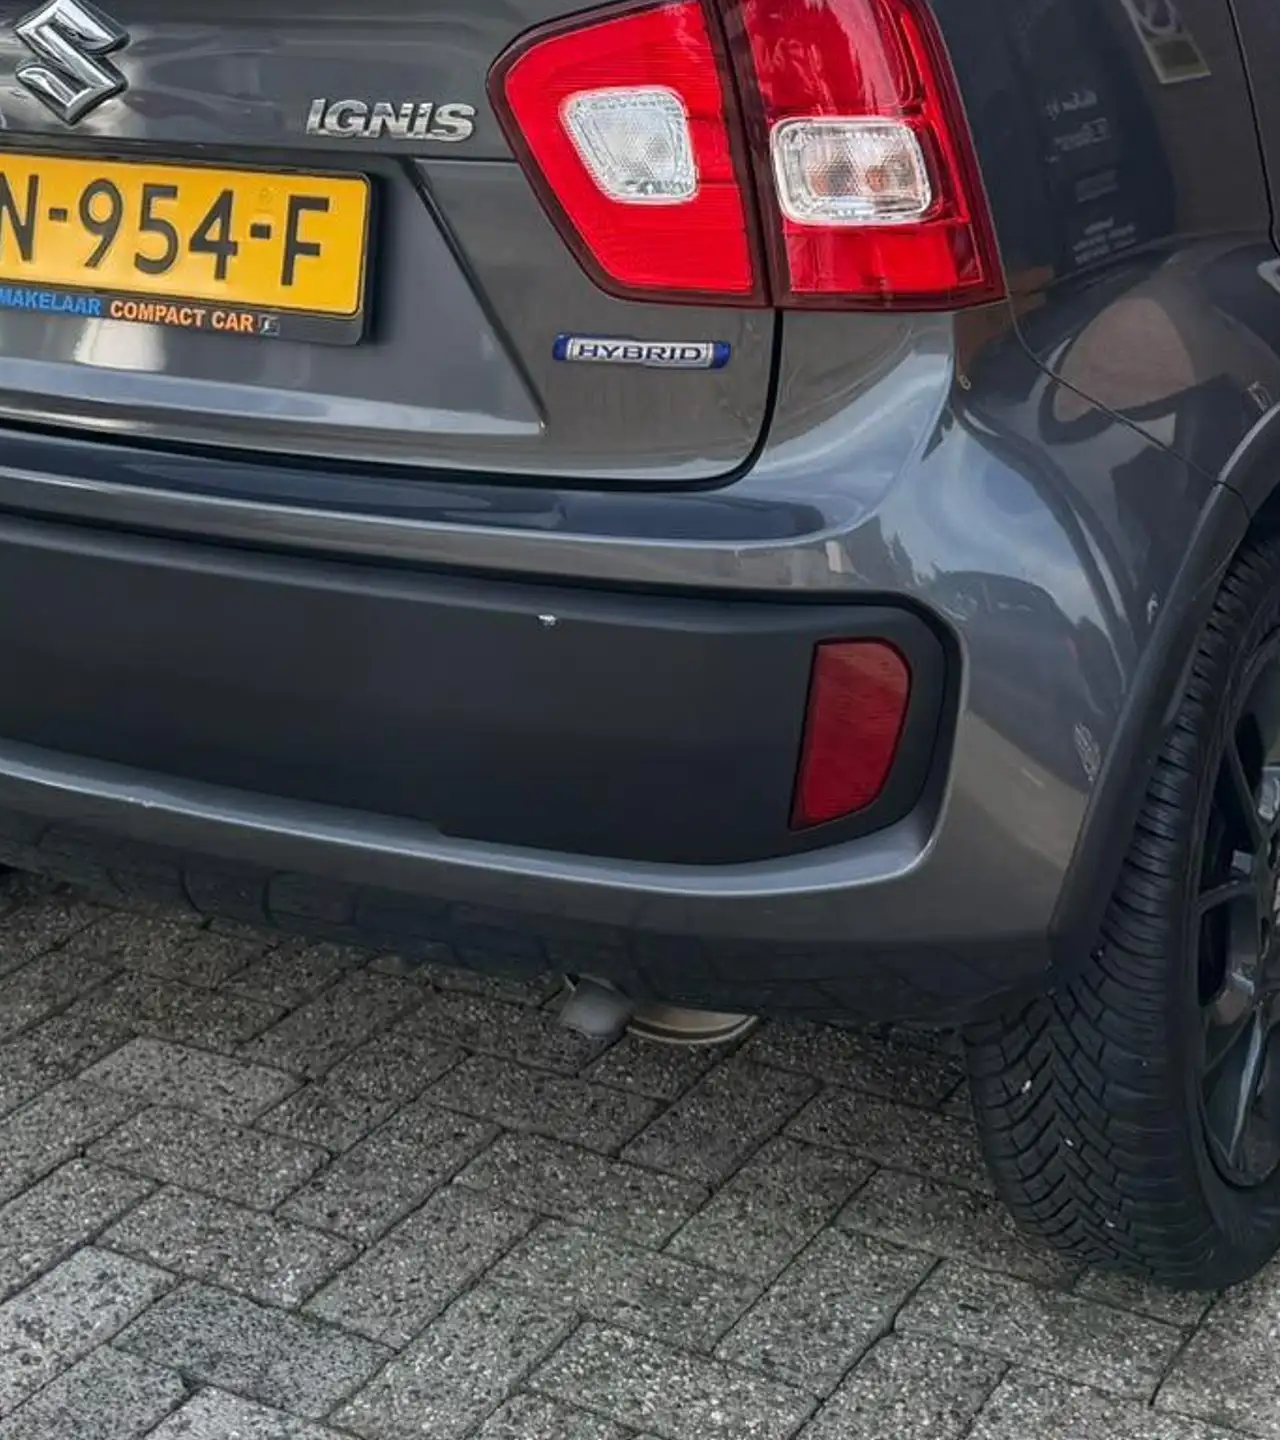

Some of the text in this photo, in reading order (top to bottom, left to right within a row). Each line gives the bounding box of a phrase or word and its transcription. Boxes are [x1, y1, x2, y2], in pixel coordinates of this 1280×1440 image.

[306, 97, 476, 143] IGNIS
[109, 300, 208, 327] COMPACT
[210, 311, 255, 333] CAR
[578, 343, 702, 361] HYBRID
